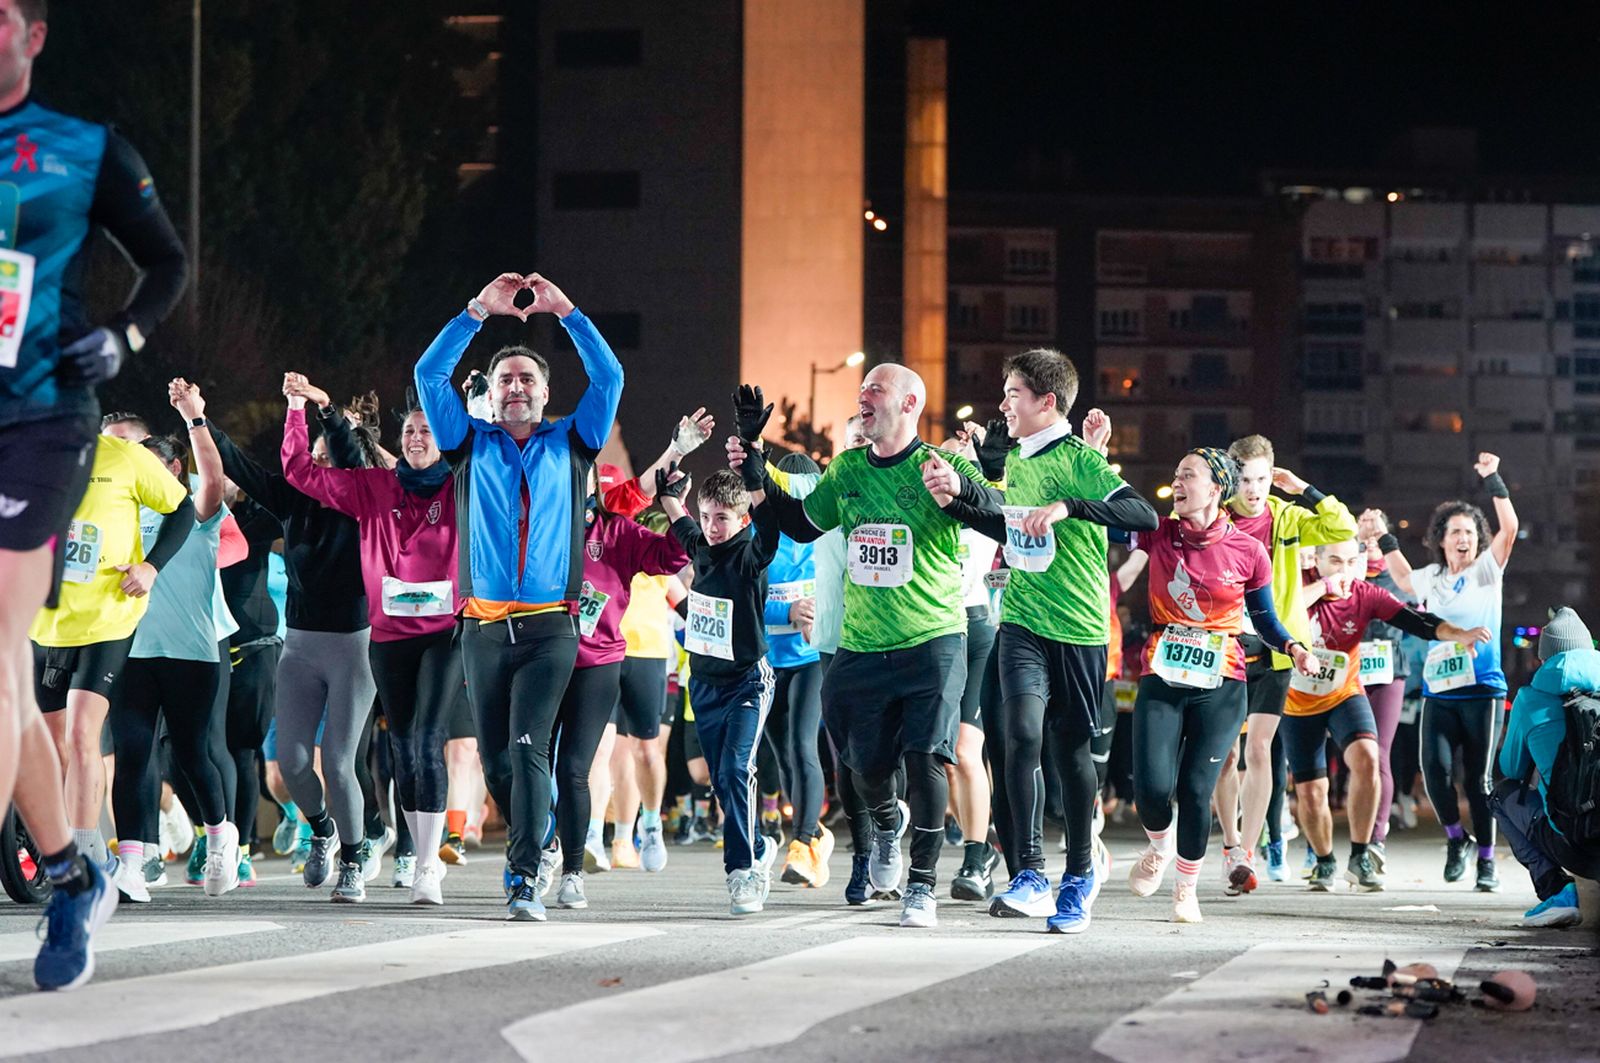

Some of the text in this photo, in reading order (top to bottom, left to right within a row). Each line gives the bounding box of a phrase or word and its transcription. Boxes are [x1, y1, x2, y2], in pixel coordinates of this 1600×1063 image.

[854, 535, 867, 543] SAN
[859, 544, 898, 566] 3913
[1177, 591, 1195, 610] 43
[691, 612, 726, 639] 13226
[1165, 643, 1216, 668] 13799
